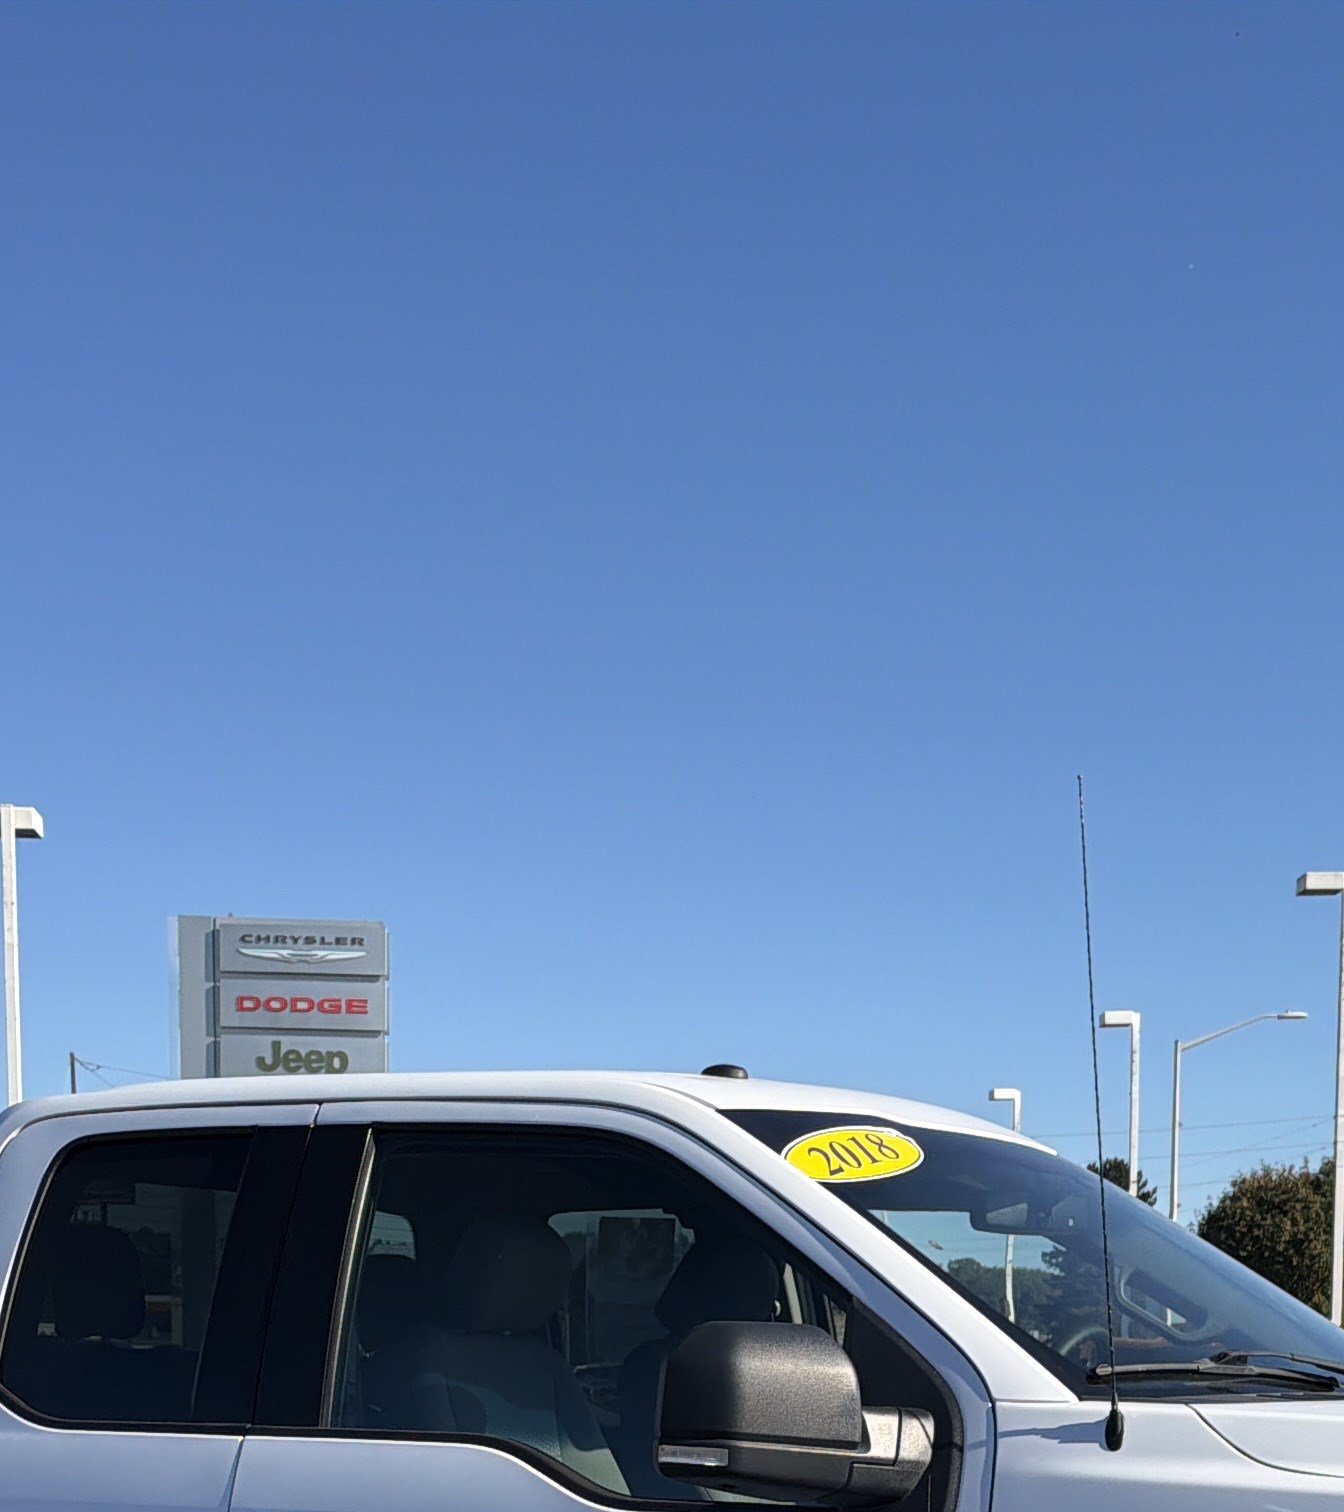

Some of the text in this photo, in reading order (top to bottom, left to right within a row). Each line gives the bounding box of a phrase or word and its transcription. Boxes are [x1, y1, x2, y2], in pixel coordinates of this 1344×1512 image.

[239, 934, 365, 946] CHRYSLER
[236, 995, 368, 1014] DODGE
[255, 1040, 349, 1074] Jeep
[807, 1133, 900, 1177] 2018
